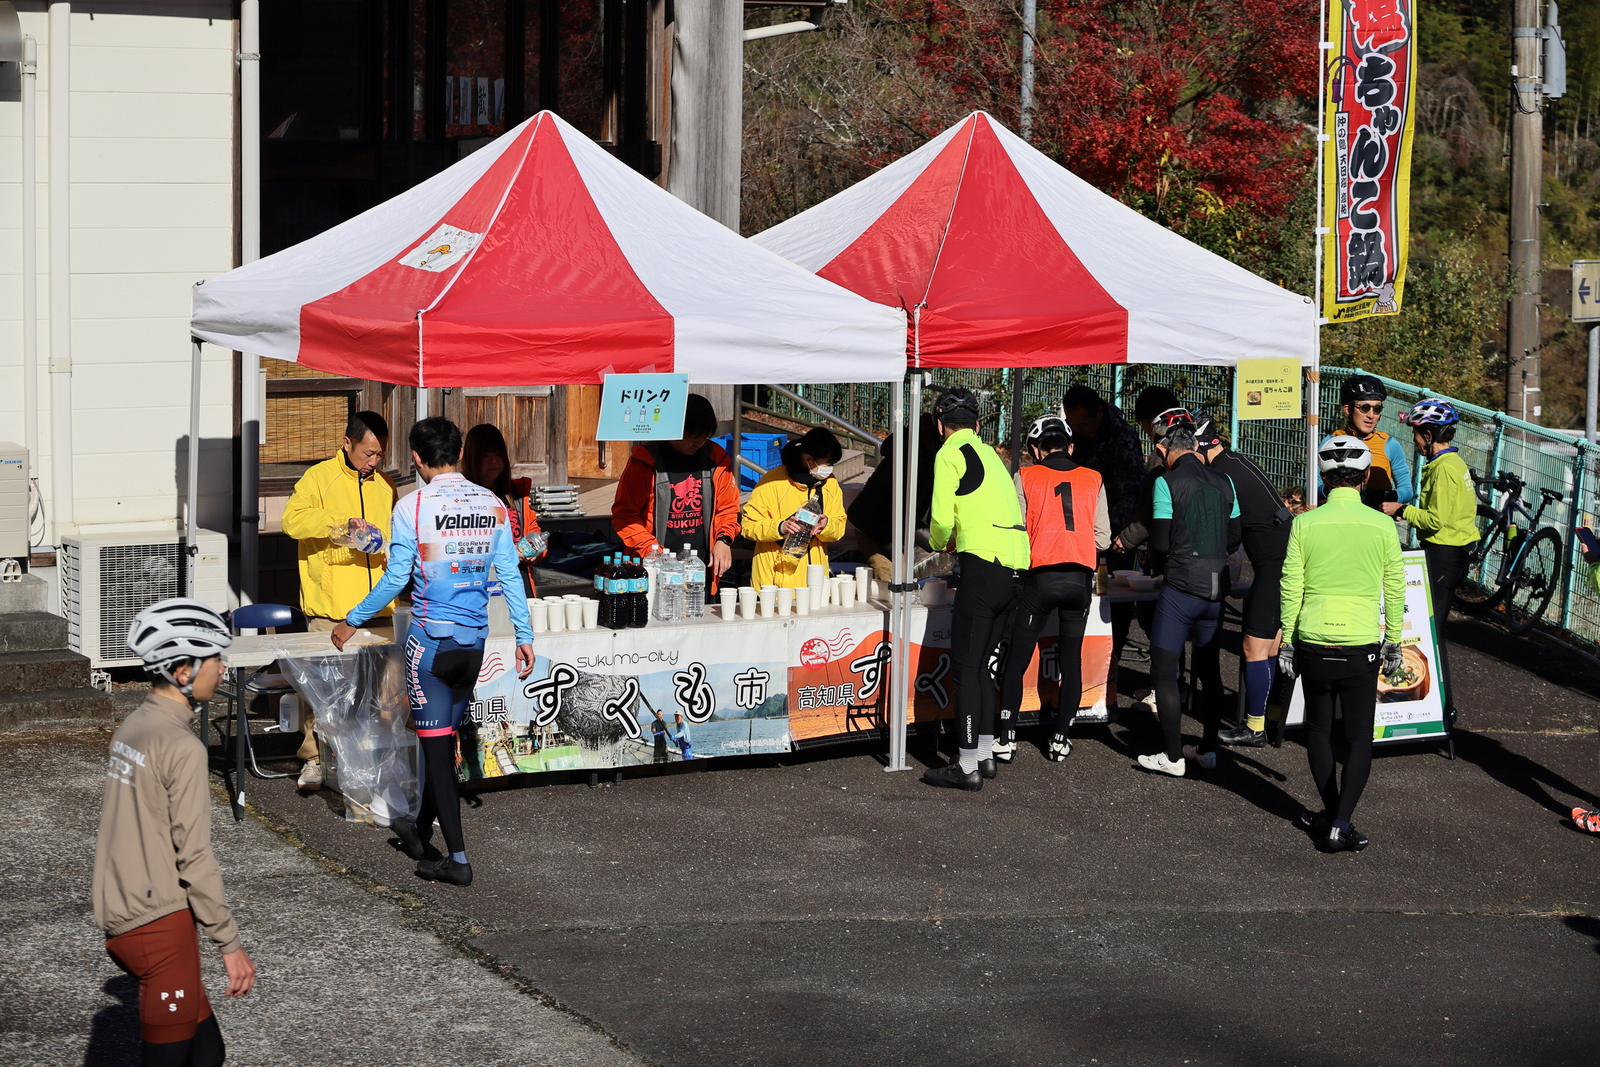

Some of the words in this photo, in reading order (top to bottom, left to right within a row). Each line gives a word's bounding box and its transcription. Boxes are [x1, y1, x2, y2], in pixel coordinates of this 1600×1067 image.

[621, 389, 670, 403] ドリンク
[1054, 482, 1075, 532] 1
[435, 514, 496, 530] Velolien
[441, 529, 493, 537] MATSUYAMA
[577, 650, 679, 668] sukumo-city
[412, 646, 427, 704] MATSUYAMA
[460, 697, 508, 726] 知県
[524, 662, 770, 739] すくも市
[797, 683, 855, 711] 高知県
